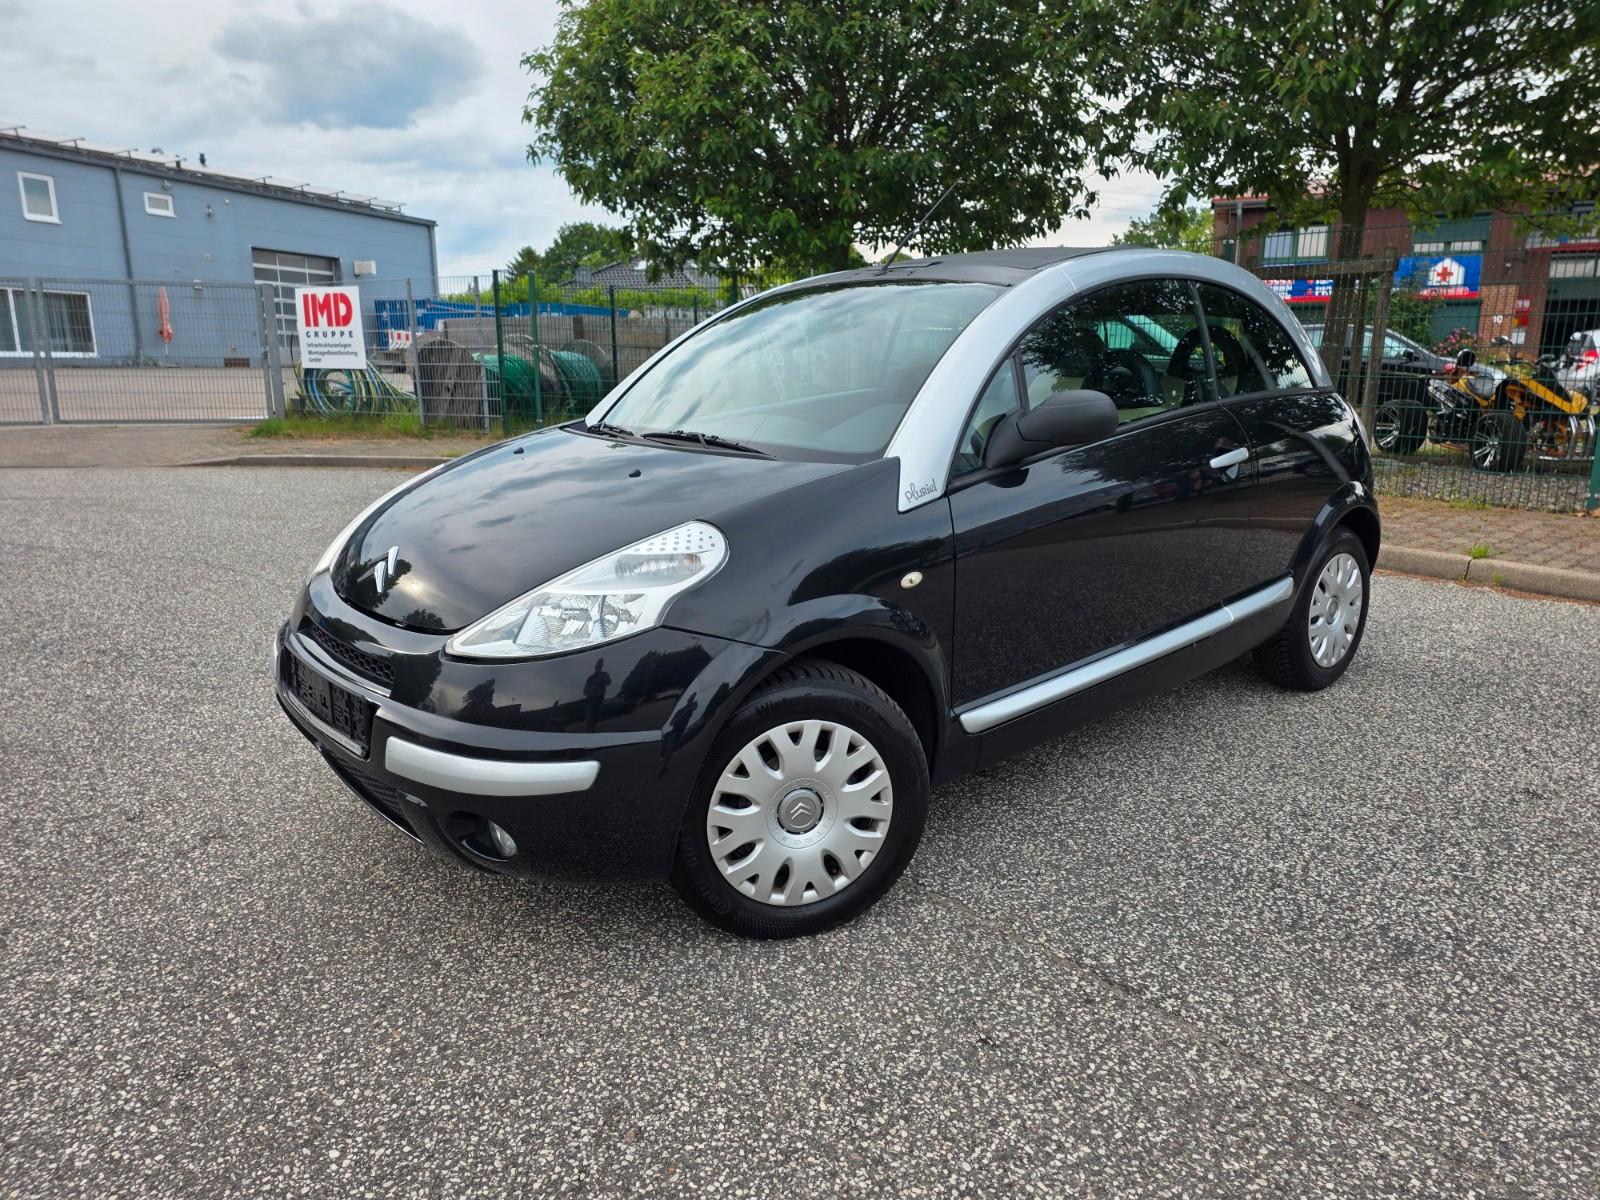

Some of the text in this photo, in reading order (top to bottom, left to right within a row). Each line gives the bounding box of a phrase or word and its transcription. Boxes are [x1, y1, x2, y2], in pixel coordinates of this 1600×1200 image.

[302, 292, 353, 327] IMD
[1492, 315, 1503, 324] 10
[306, 330, 353, 338] GRUPPE
